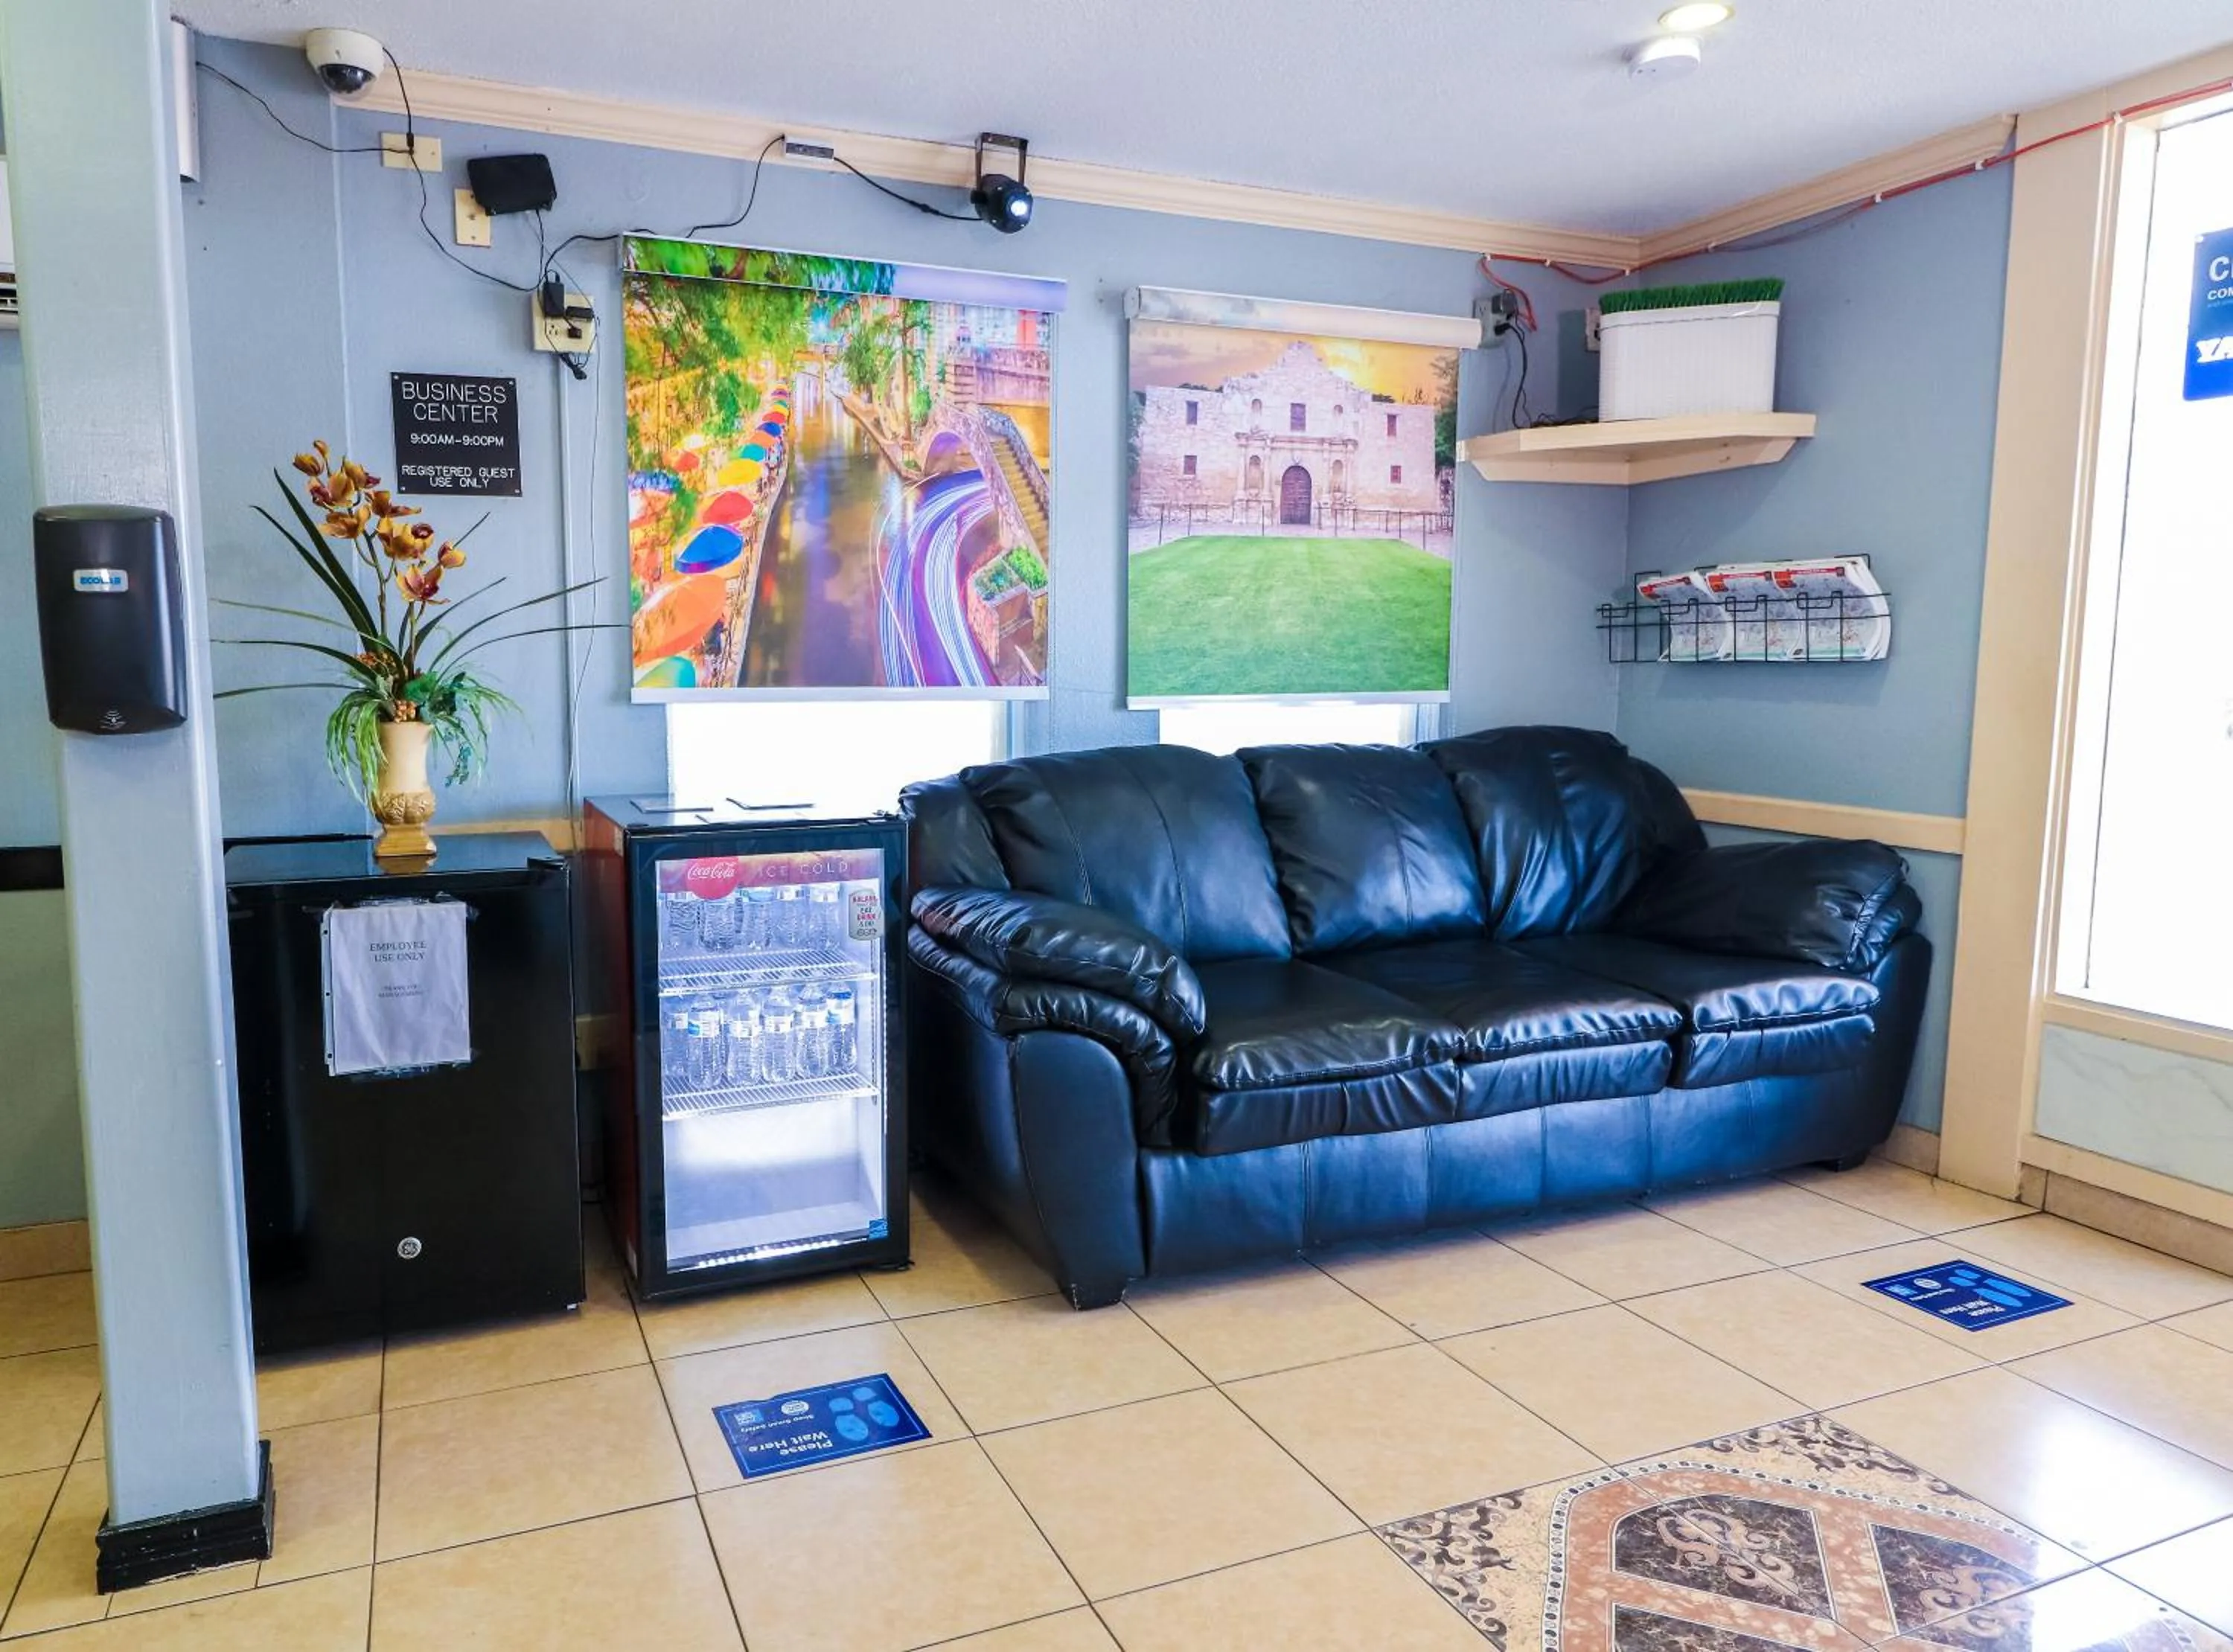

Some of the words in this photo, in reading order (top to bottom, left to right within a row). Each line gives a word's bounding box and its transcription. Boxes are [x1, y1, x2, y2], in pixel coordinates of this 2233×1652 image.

[401, 382, 507, 403] BUSINESS
[413, 403, 498, 423] CENTER
[401, 465, 472, 477] REGISTERED
[479, 467, 515, 478] GUEST
[429, 477, 453, 487] USE
[459, 477, 489, 488] ONLY
[799, 862, 848, 875] COLD
[369, 941, 427, 951] EMPLOYEE
[374, 953, 393, 962] USE
[790, 1431, 828, 1444] Wait
[748, 1439, 788, 1453] Here
[779, 1439, 833, 1455] Please
